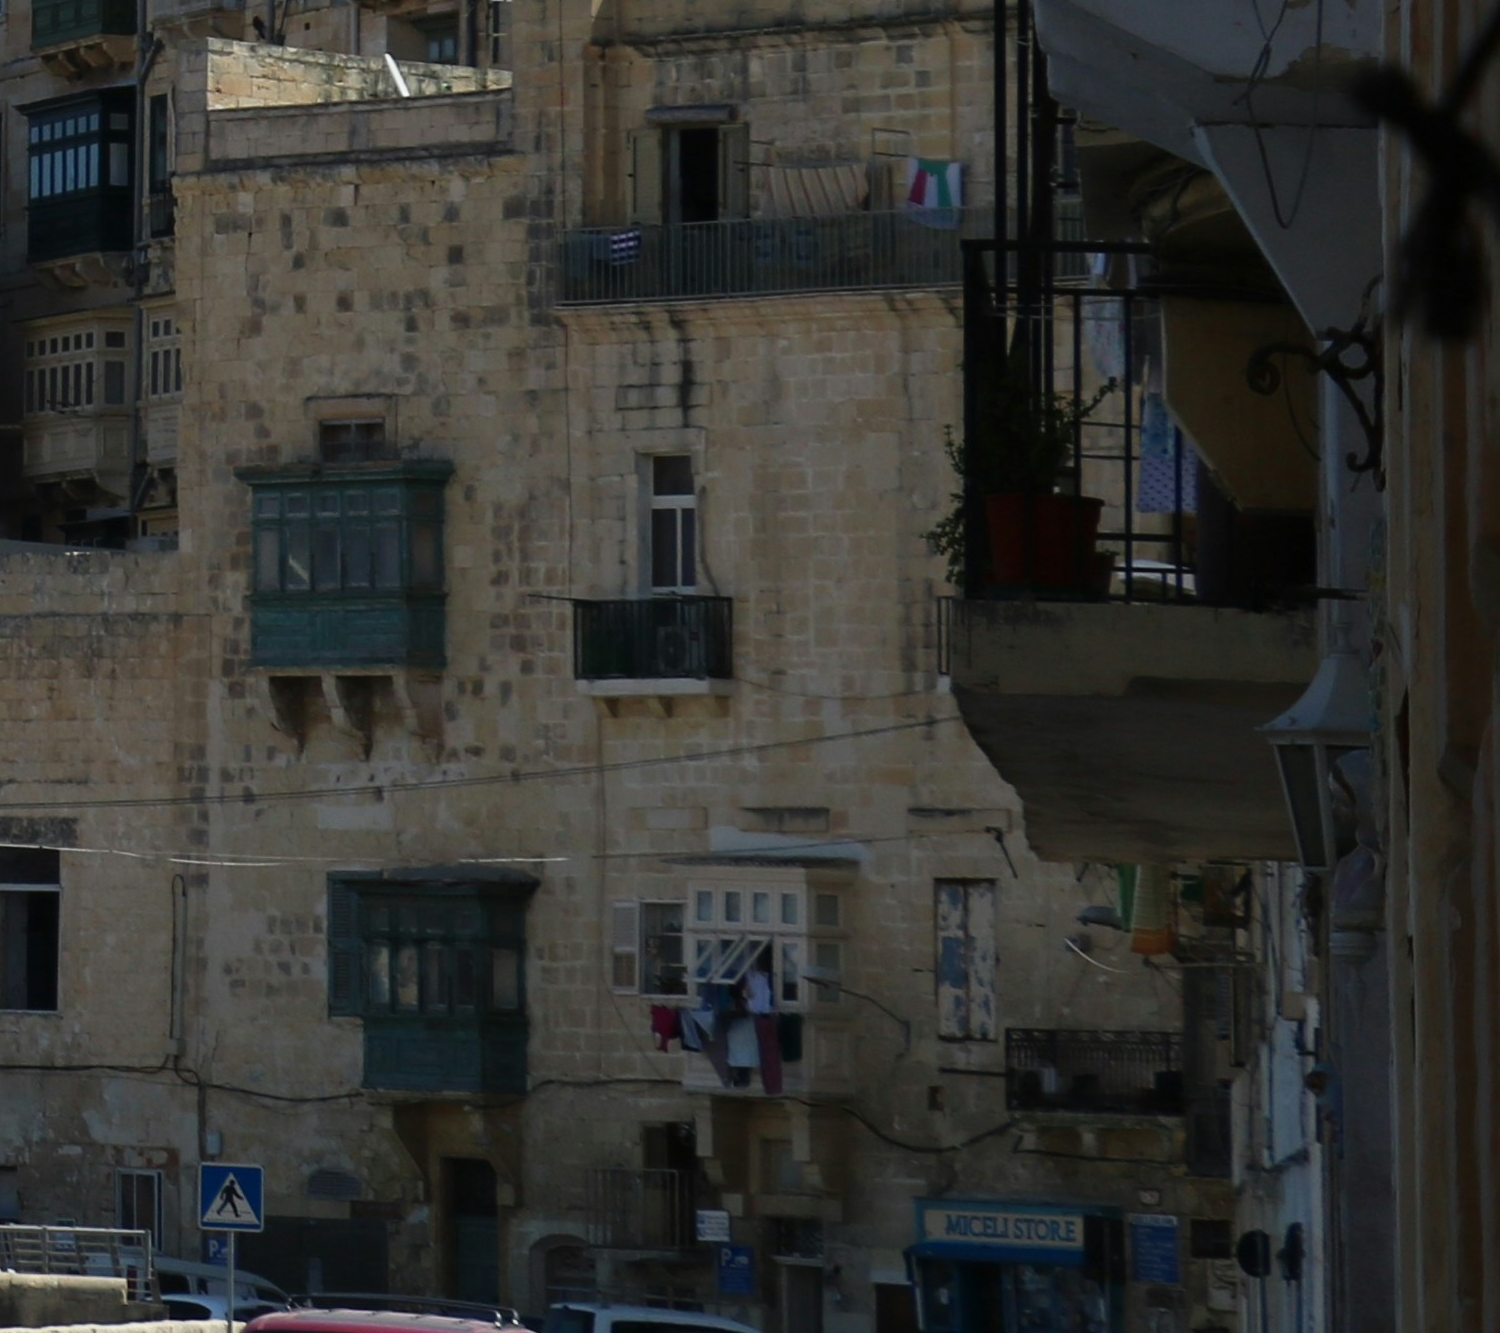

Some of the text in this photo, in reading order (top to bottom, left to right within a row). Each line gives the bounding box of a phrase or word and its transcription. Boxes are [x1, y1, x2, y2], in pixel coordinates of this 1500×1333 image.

[945, 1214, 1077, 1241] MICELI STORE
[209, 1239, 219, 1258] P
[721, 1248, 732, 1267] P
